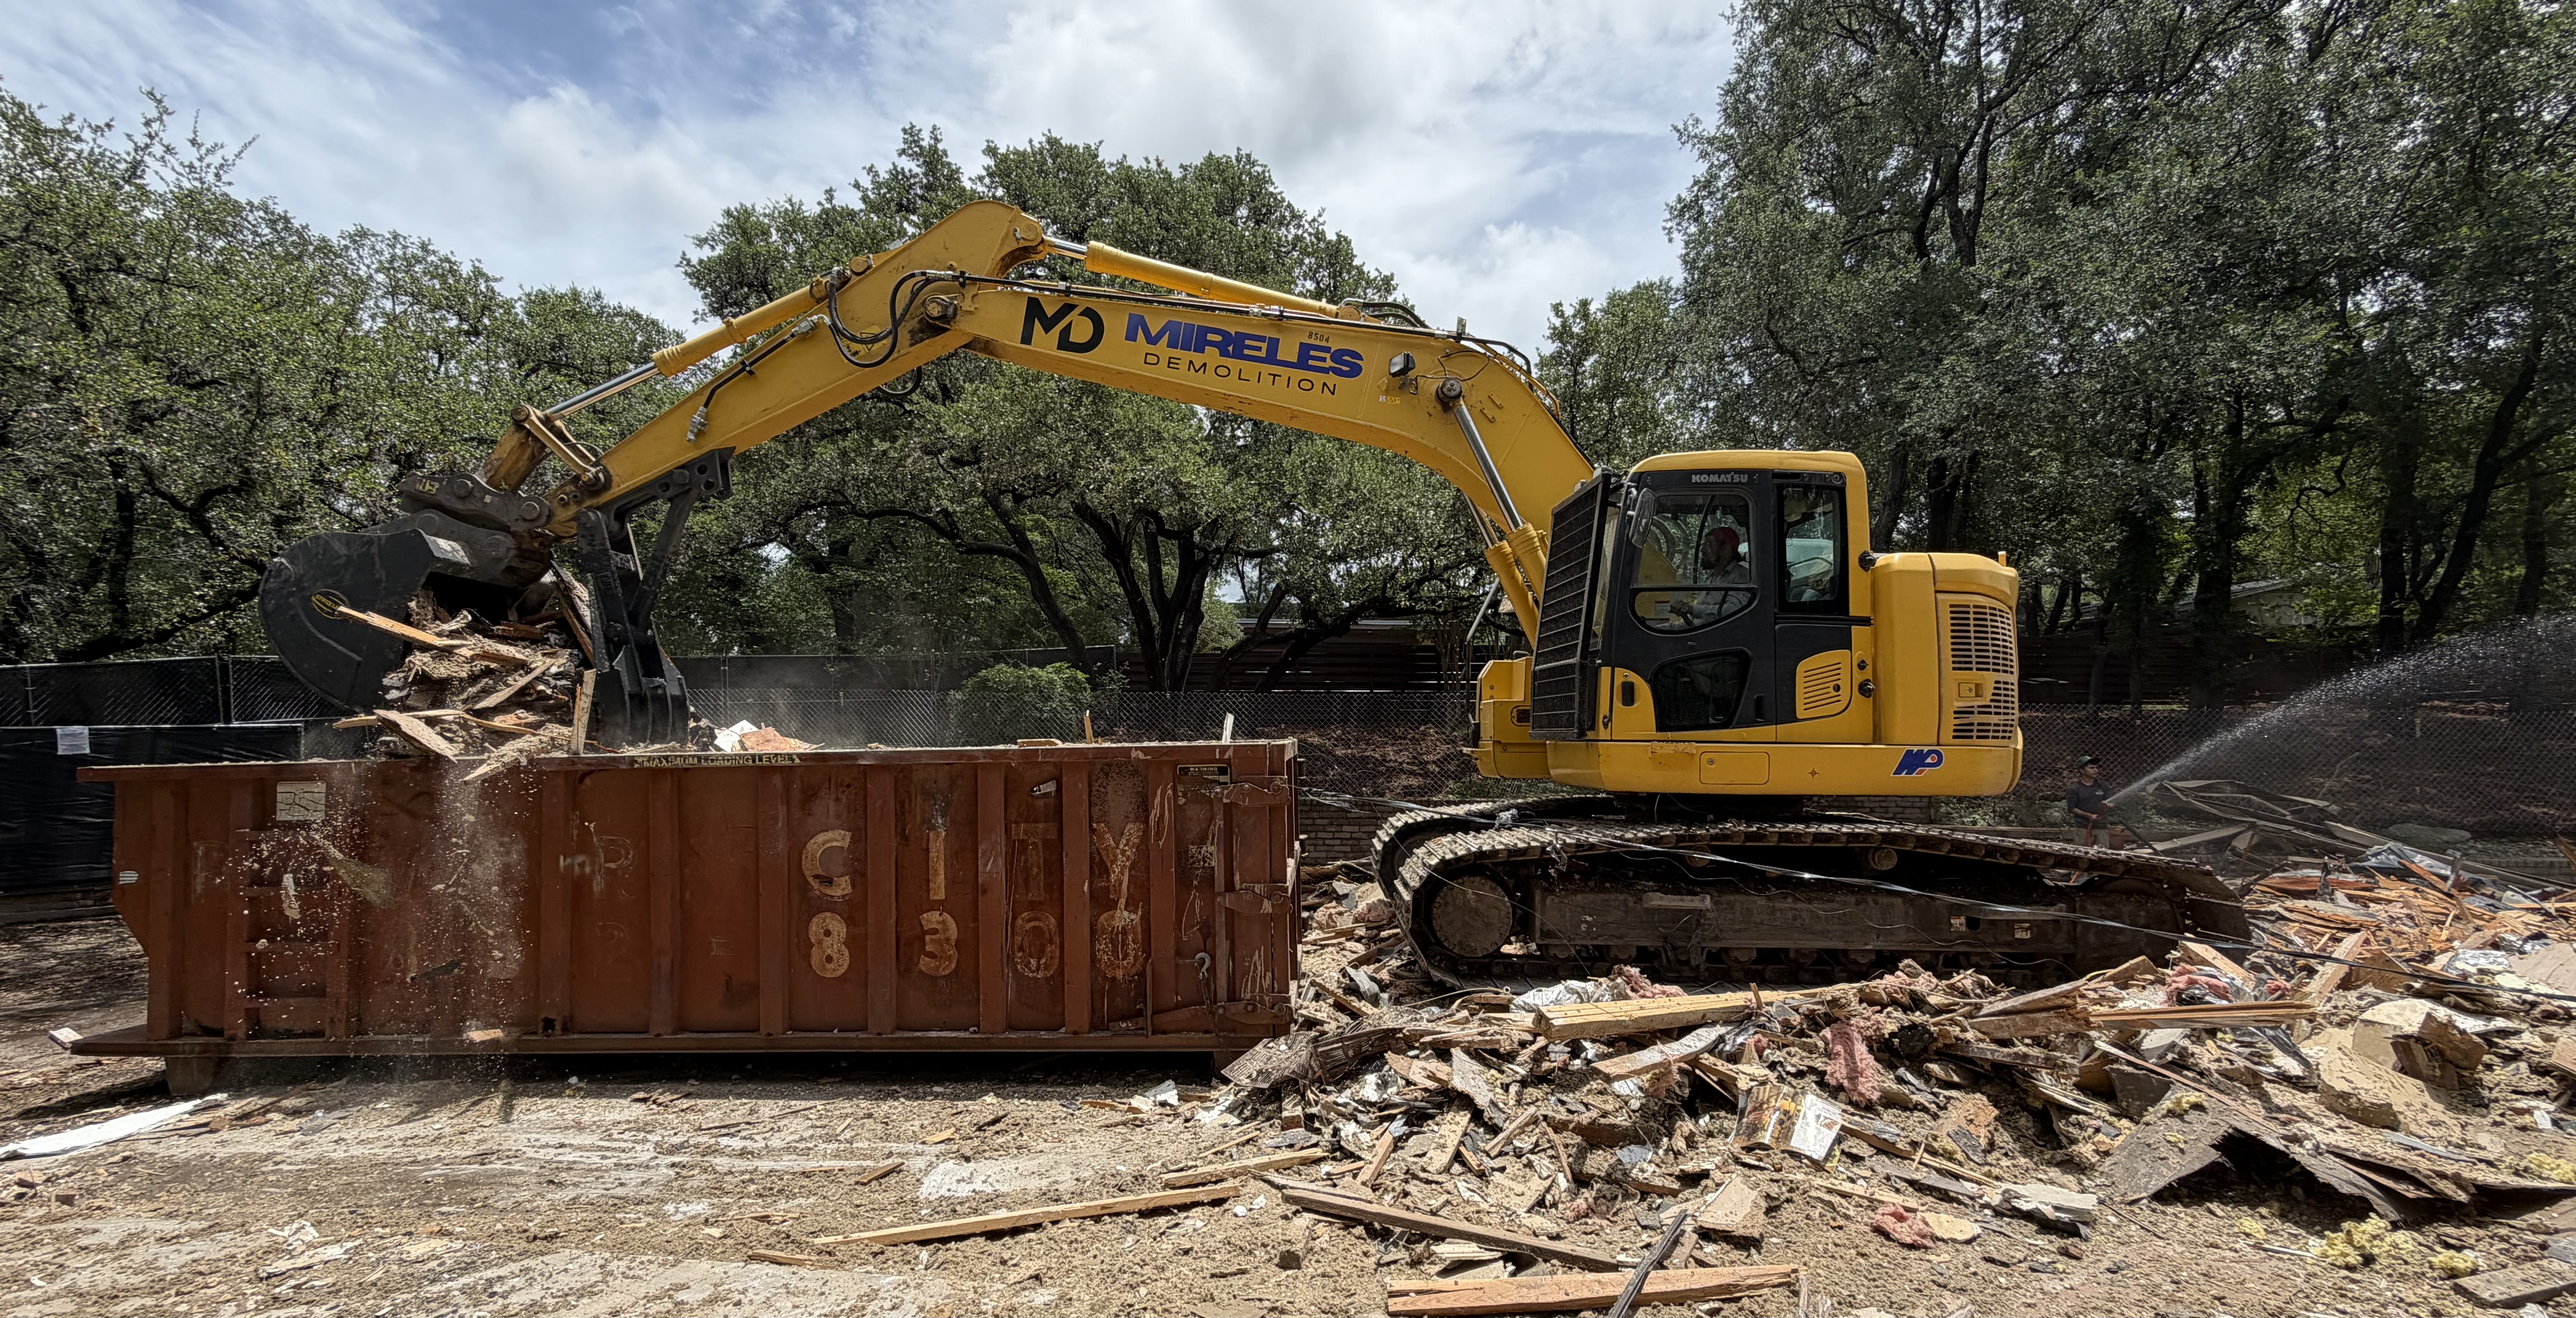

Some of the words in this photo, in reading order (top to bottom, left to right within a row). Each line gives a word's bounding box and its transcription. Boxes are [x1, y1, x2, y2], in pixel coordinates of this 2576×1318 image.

[1020, 296, 1104, 354] MD
[1125, 312, 1363, 378] MIRELES
[1308, 331, 1330, 343] 8504
[1144, 352, 1337, 396] DEMOLITION
[1691, 472, 1748, 483] KOMATSU
[702, 756, 753, 765] LOADING
[802, 823, 1144, 901] CITY
[808, 910, 1145, 980] 8300
